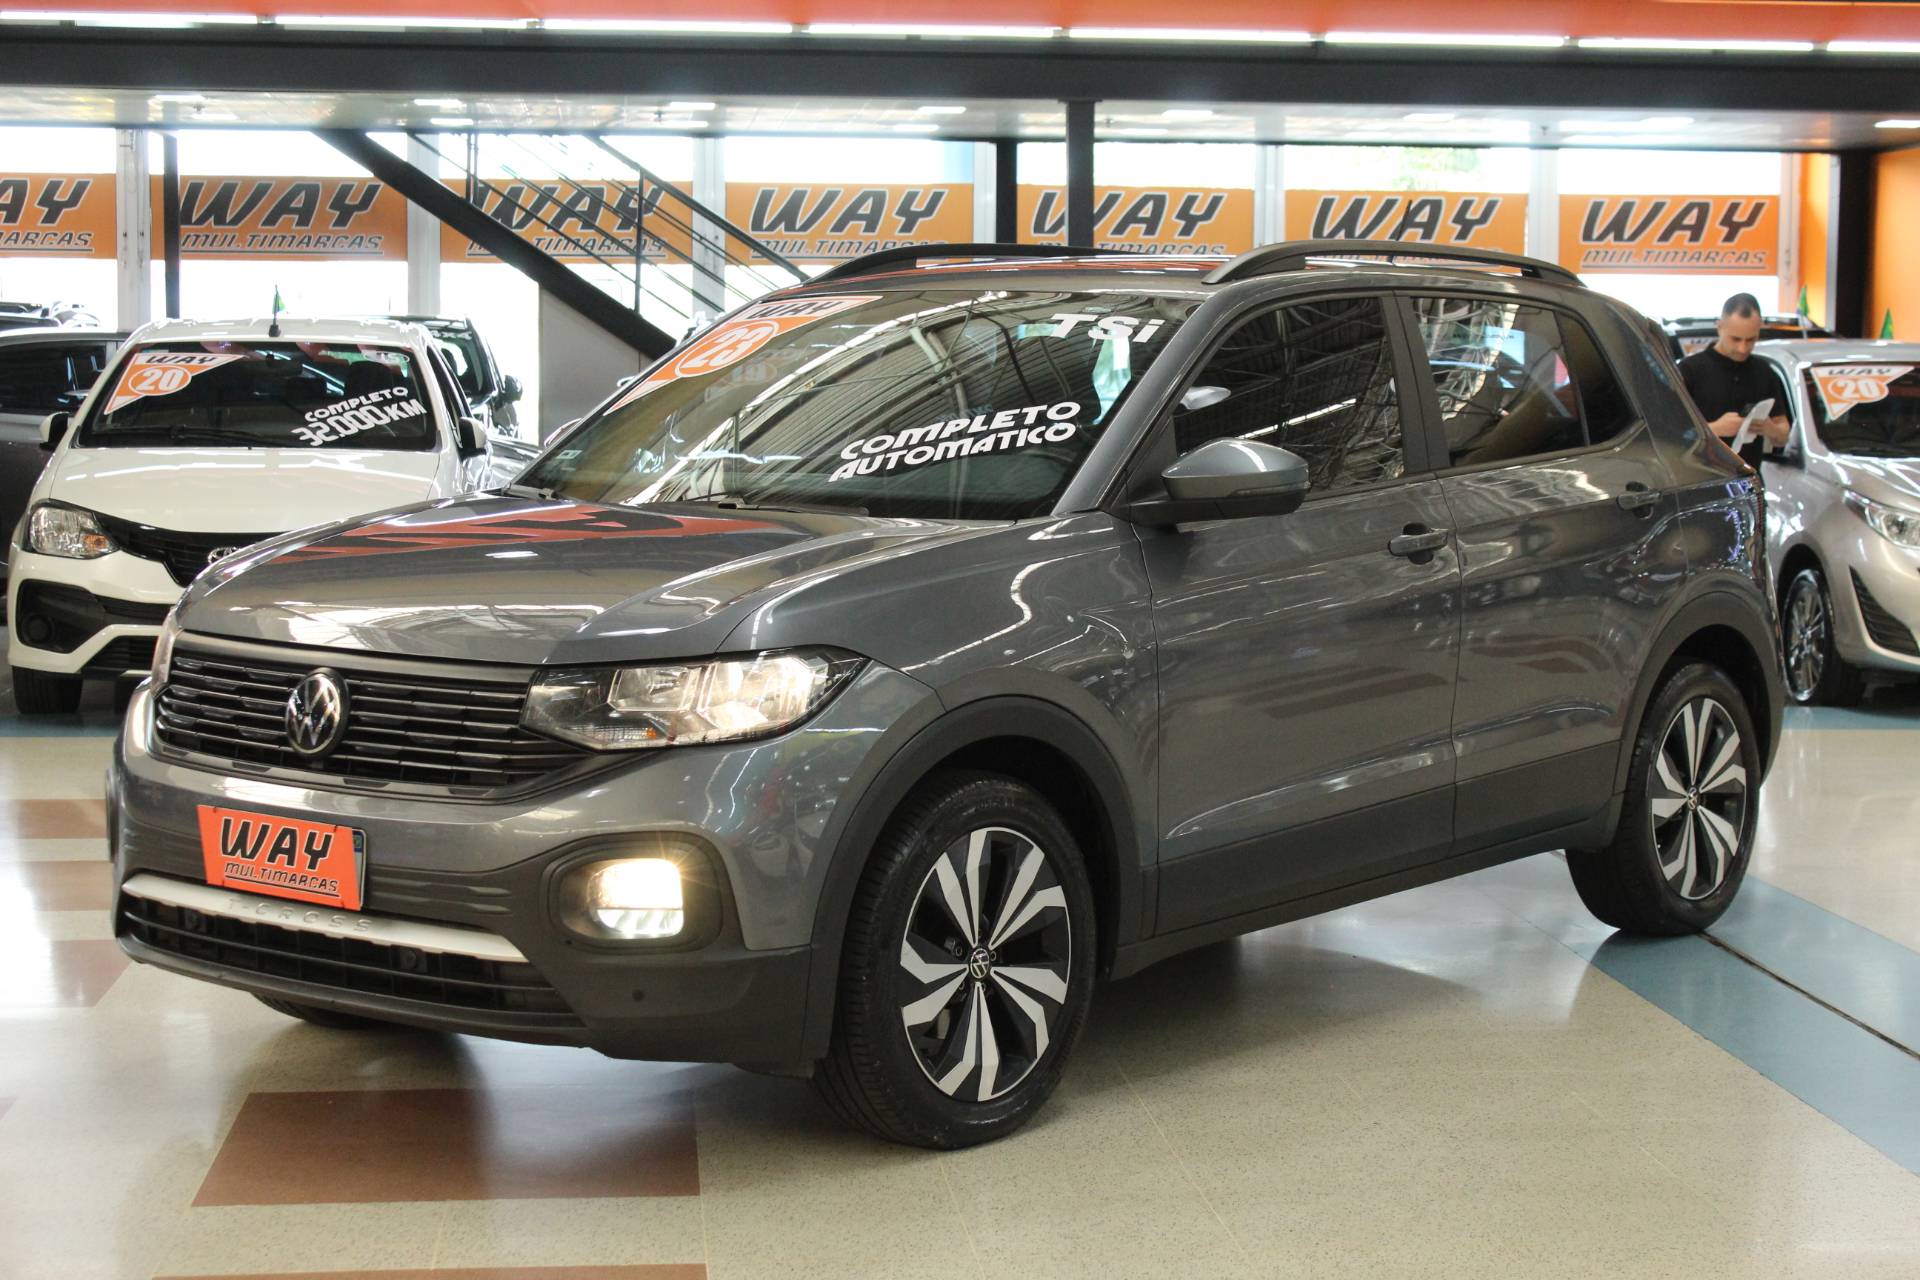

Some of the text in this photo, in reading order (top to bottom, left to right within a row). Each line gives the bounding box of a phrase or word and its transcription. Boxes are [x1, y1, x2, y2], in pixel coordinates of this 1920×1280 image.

[180, 180, 384, 229] WAY
[472, 184, 666, 232] WAY
[750, 187, 949, 235] WAY
[1032, 189, 1227, 238] WAY
[1311, 194, 1503, 243] WAY
[1580, 198, 1768, 245] WAY
[0, 231, 92, 246] ARCAS
[181, 233, 383, 249] MULTIMARCAS
[1582, 250, 1767, 264] MULTIMARCAS
[746, 301, 843, 319] WAY
[1050, 313, 1166, 343] TSi
[146, 355, 217, 364] WAY
[680, 326, 775, 369] 23
[135, 369, 186, 391] 20
[1828, 367, 1892, 376] WAY
[304, 387, 409, 422] COMPLETO
[1836, 379, 1881, 401] 20
[840, 401, 1082, 461] COMPLETO
[828, 422, 1077, 483] AUTOMATICO
[220, 816, 333, 873] WAY
[225, 862, 338, 893] MULTIMARCAS
